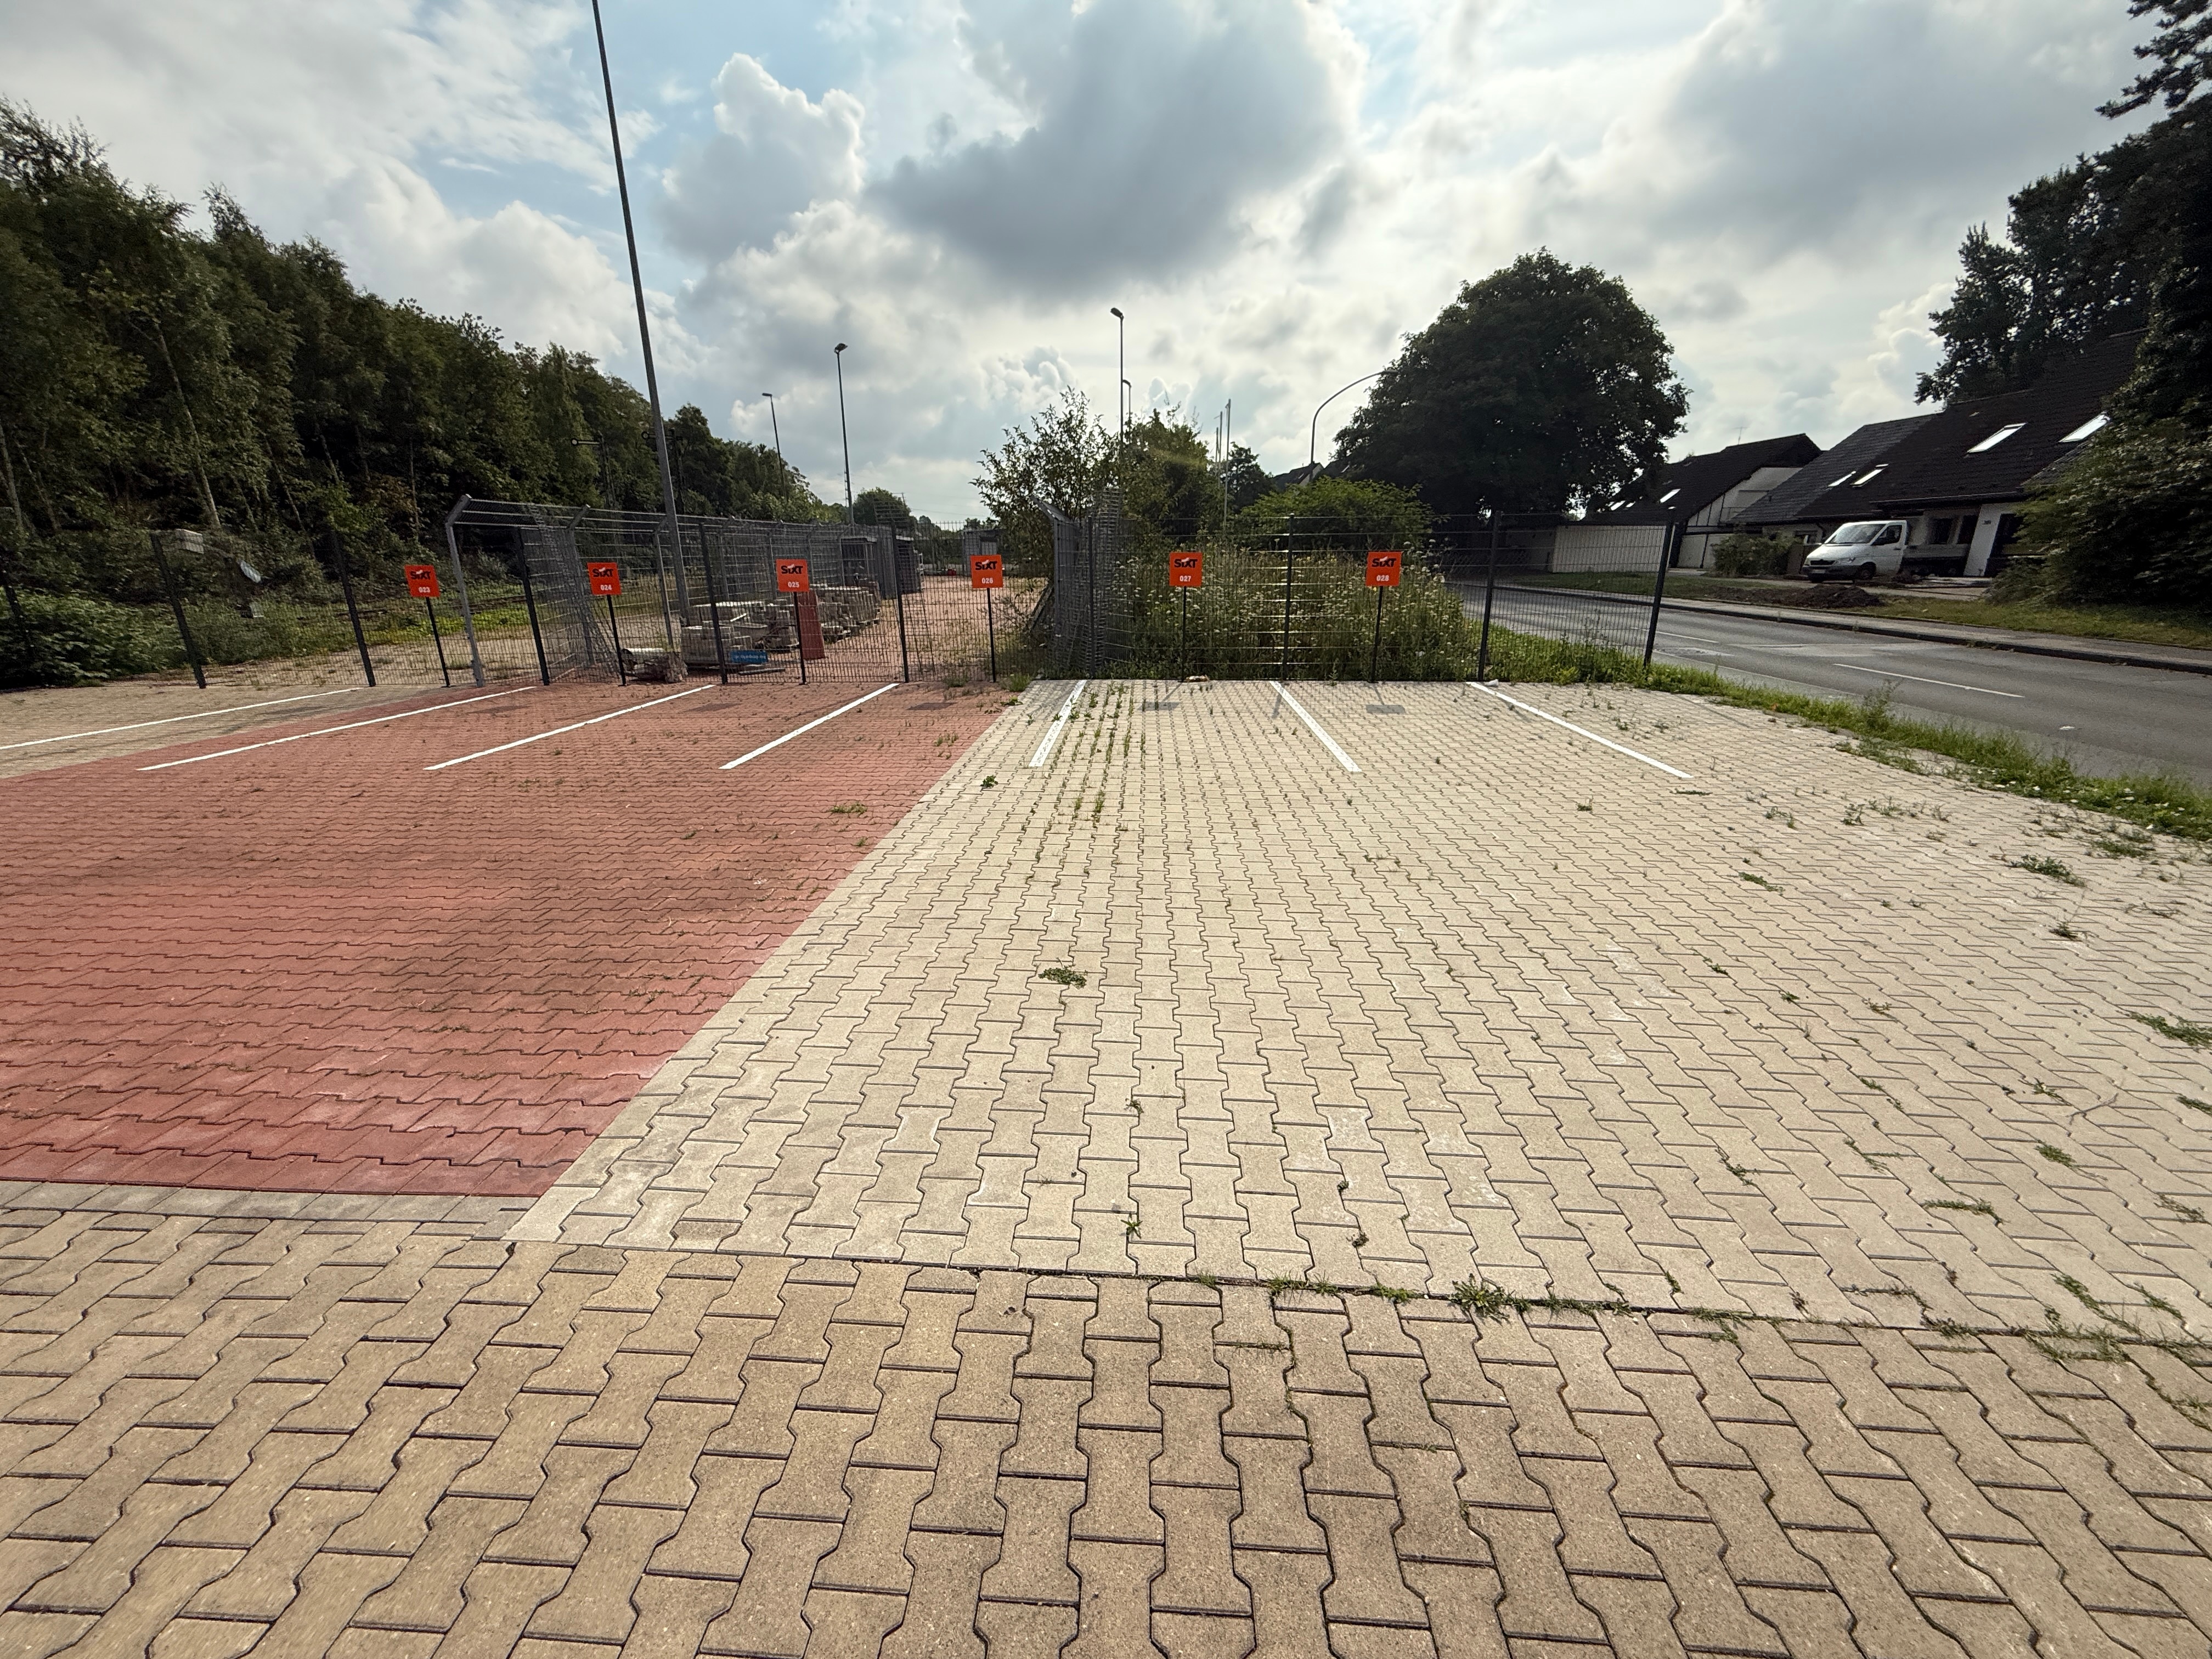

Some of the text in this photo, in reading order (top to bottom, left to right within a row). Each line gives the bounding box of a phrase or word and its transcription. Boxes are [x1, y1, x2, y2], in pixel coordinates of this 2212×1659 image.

[975, 560, 997, 570] SIXT
[1174, 557, 1198, 568] SIXT
[1372, 556, 1397, 567] SIXT
[410, 569, 431, 580] SIXT
[592, 567, 613, 578] SIXT
[781, 564, 803, 574] SIXT
